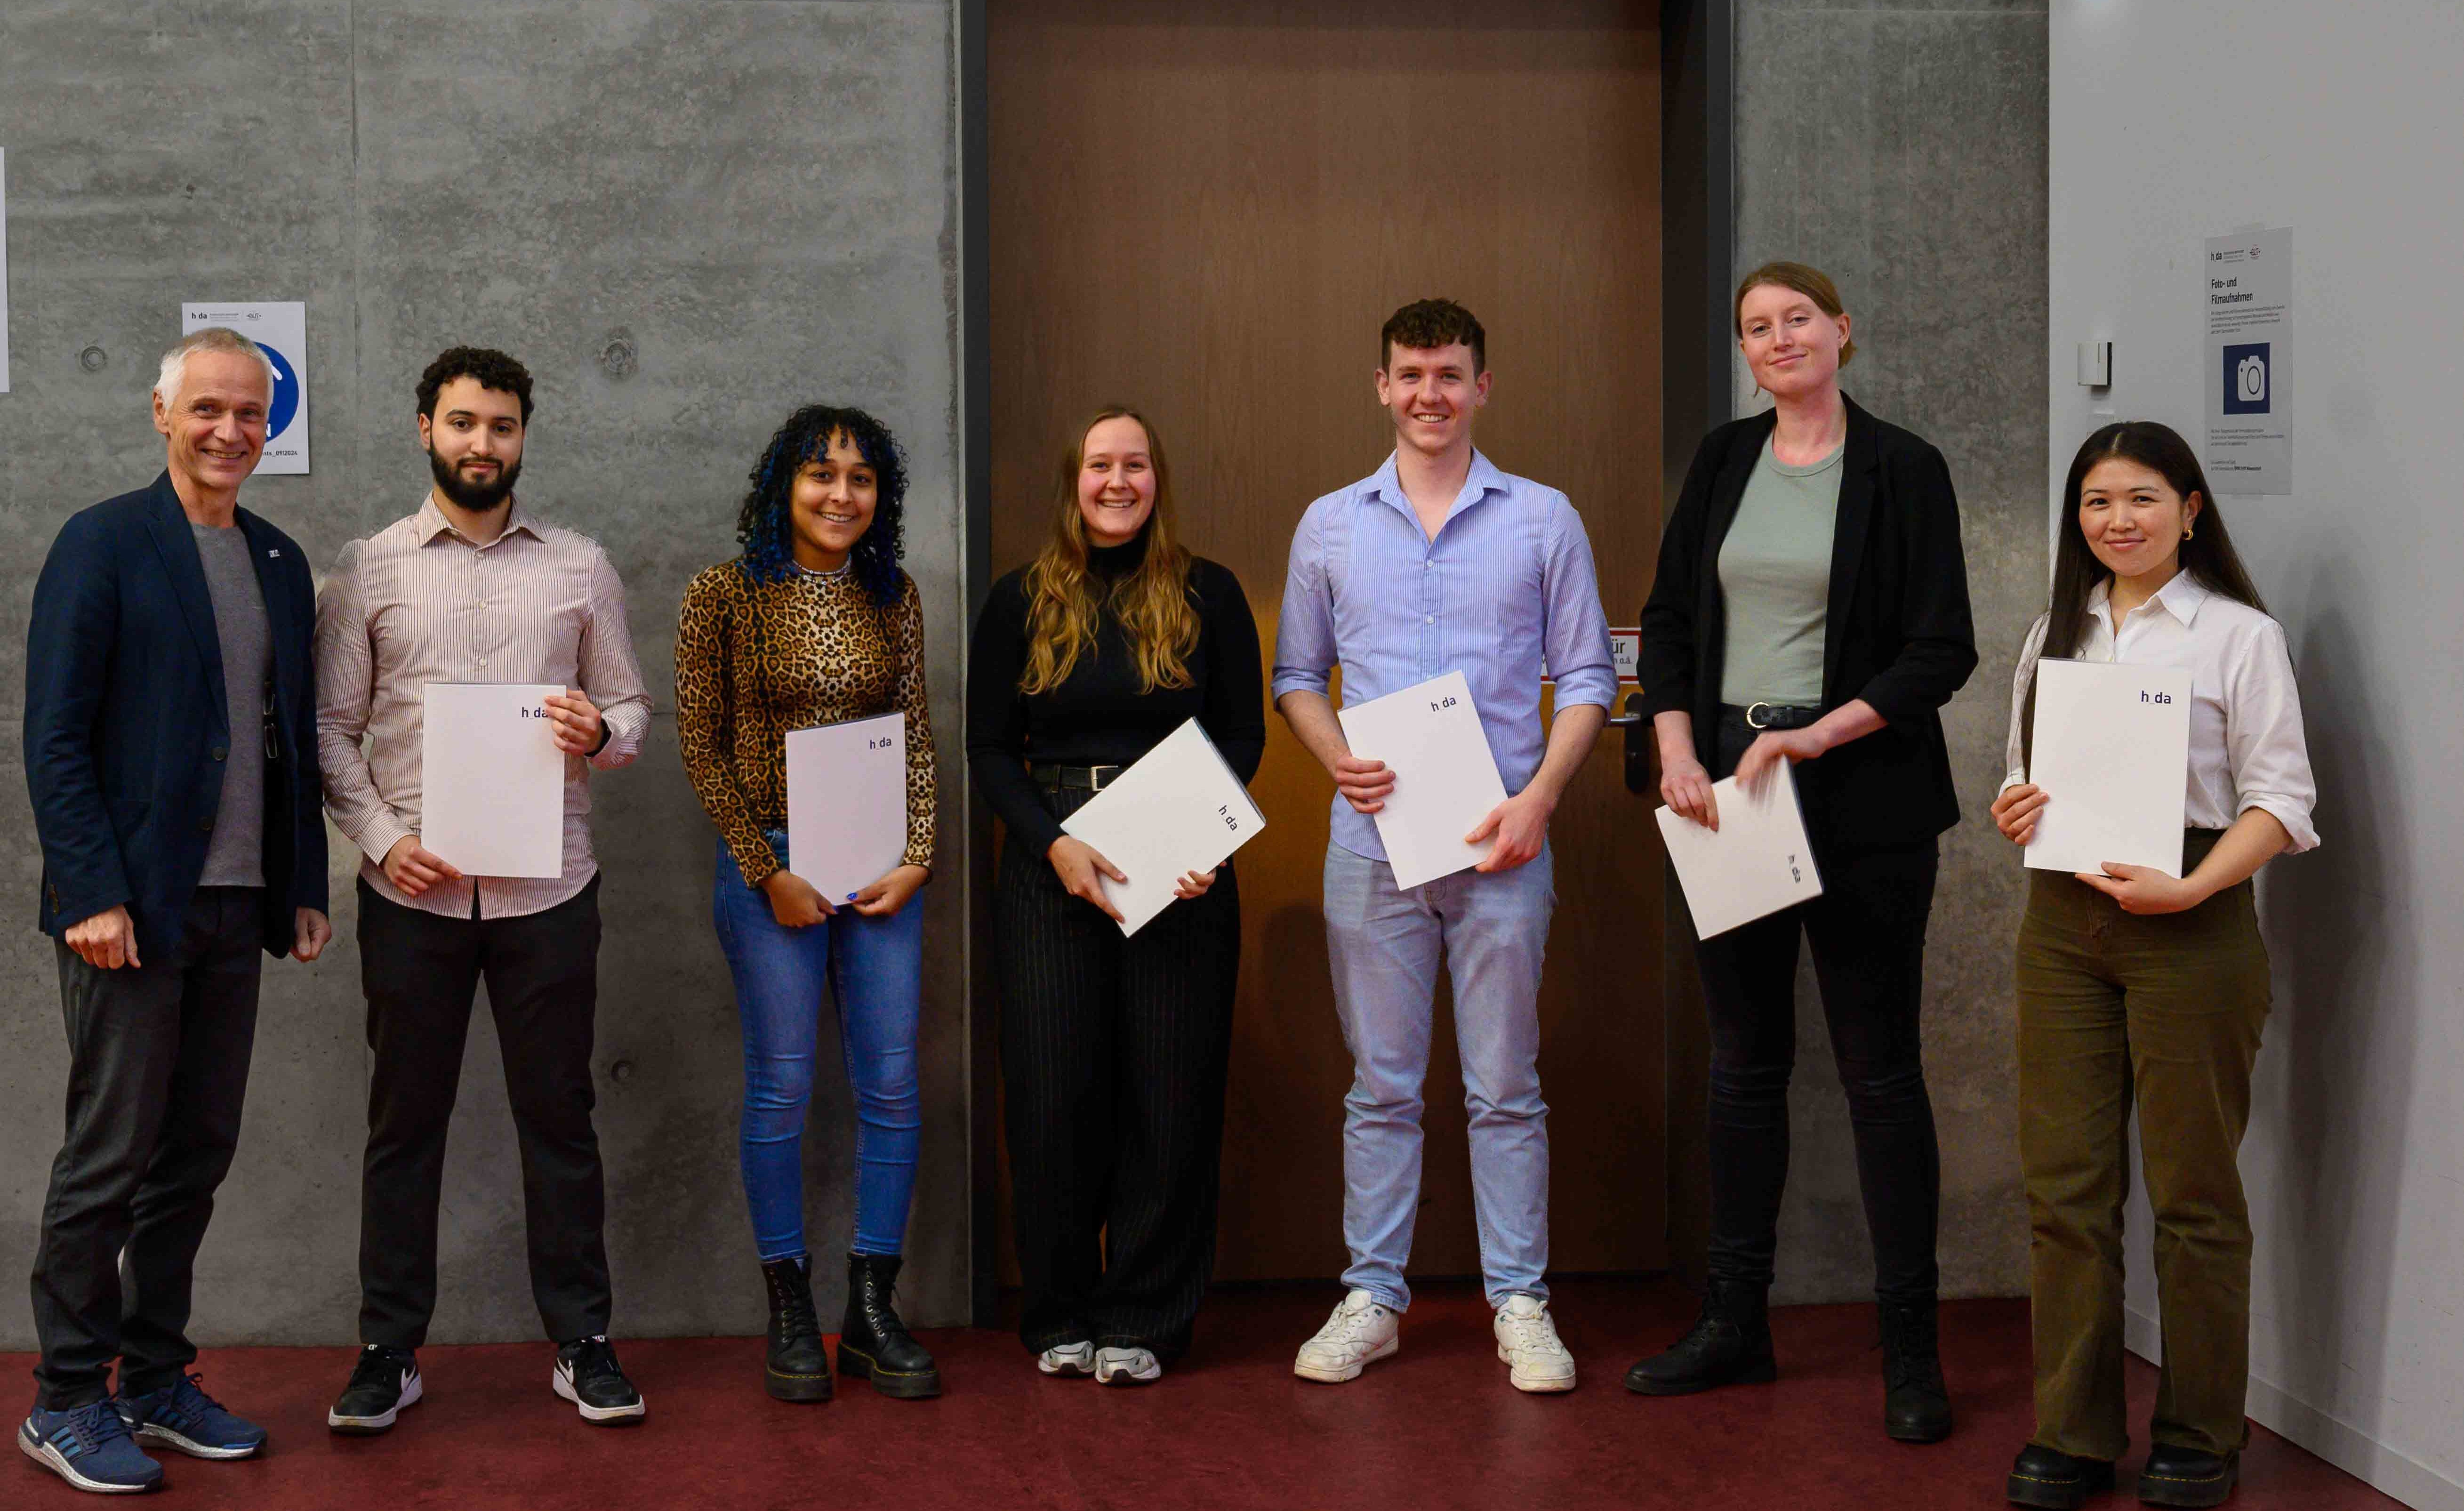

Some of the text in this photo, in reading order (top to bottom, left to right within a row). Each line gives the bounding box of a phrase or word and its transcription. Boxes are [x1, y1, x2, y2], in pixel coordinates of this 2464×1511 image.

[2211, 277, 2237, 289] Foto- und
[2211, 292, 2253, 305] Filmaufnahmen
[1612, 638, 1626, 654] ür
[2141, 690, 2172, 705] h_da
